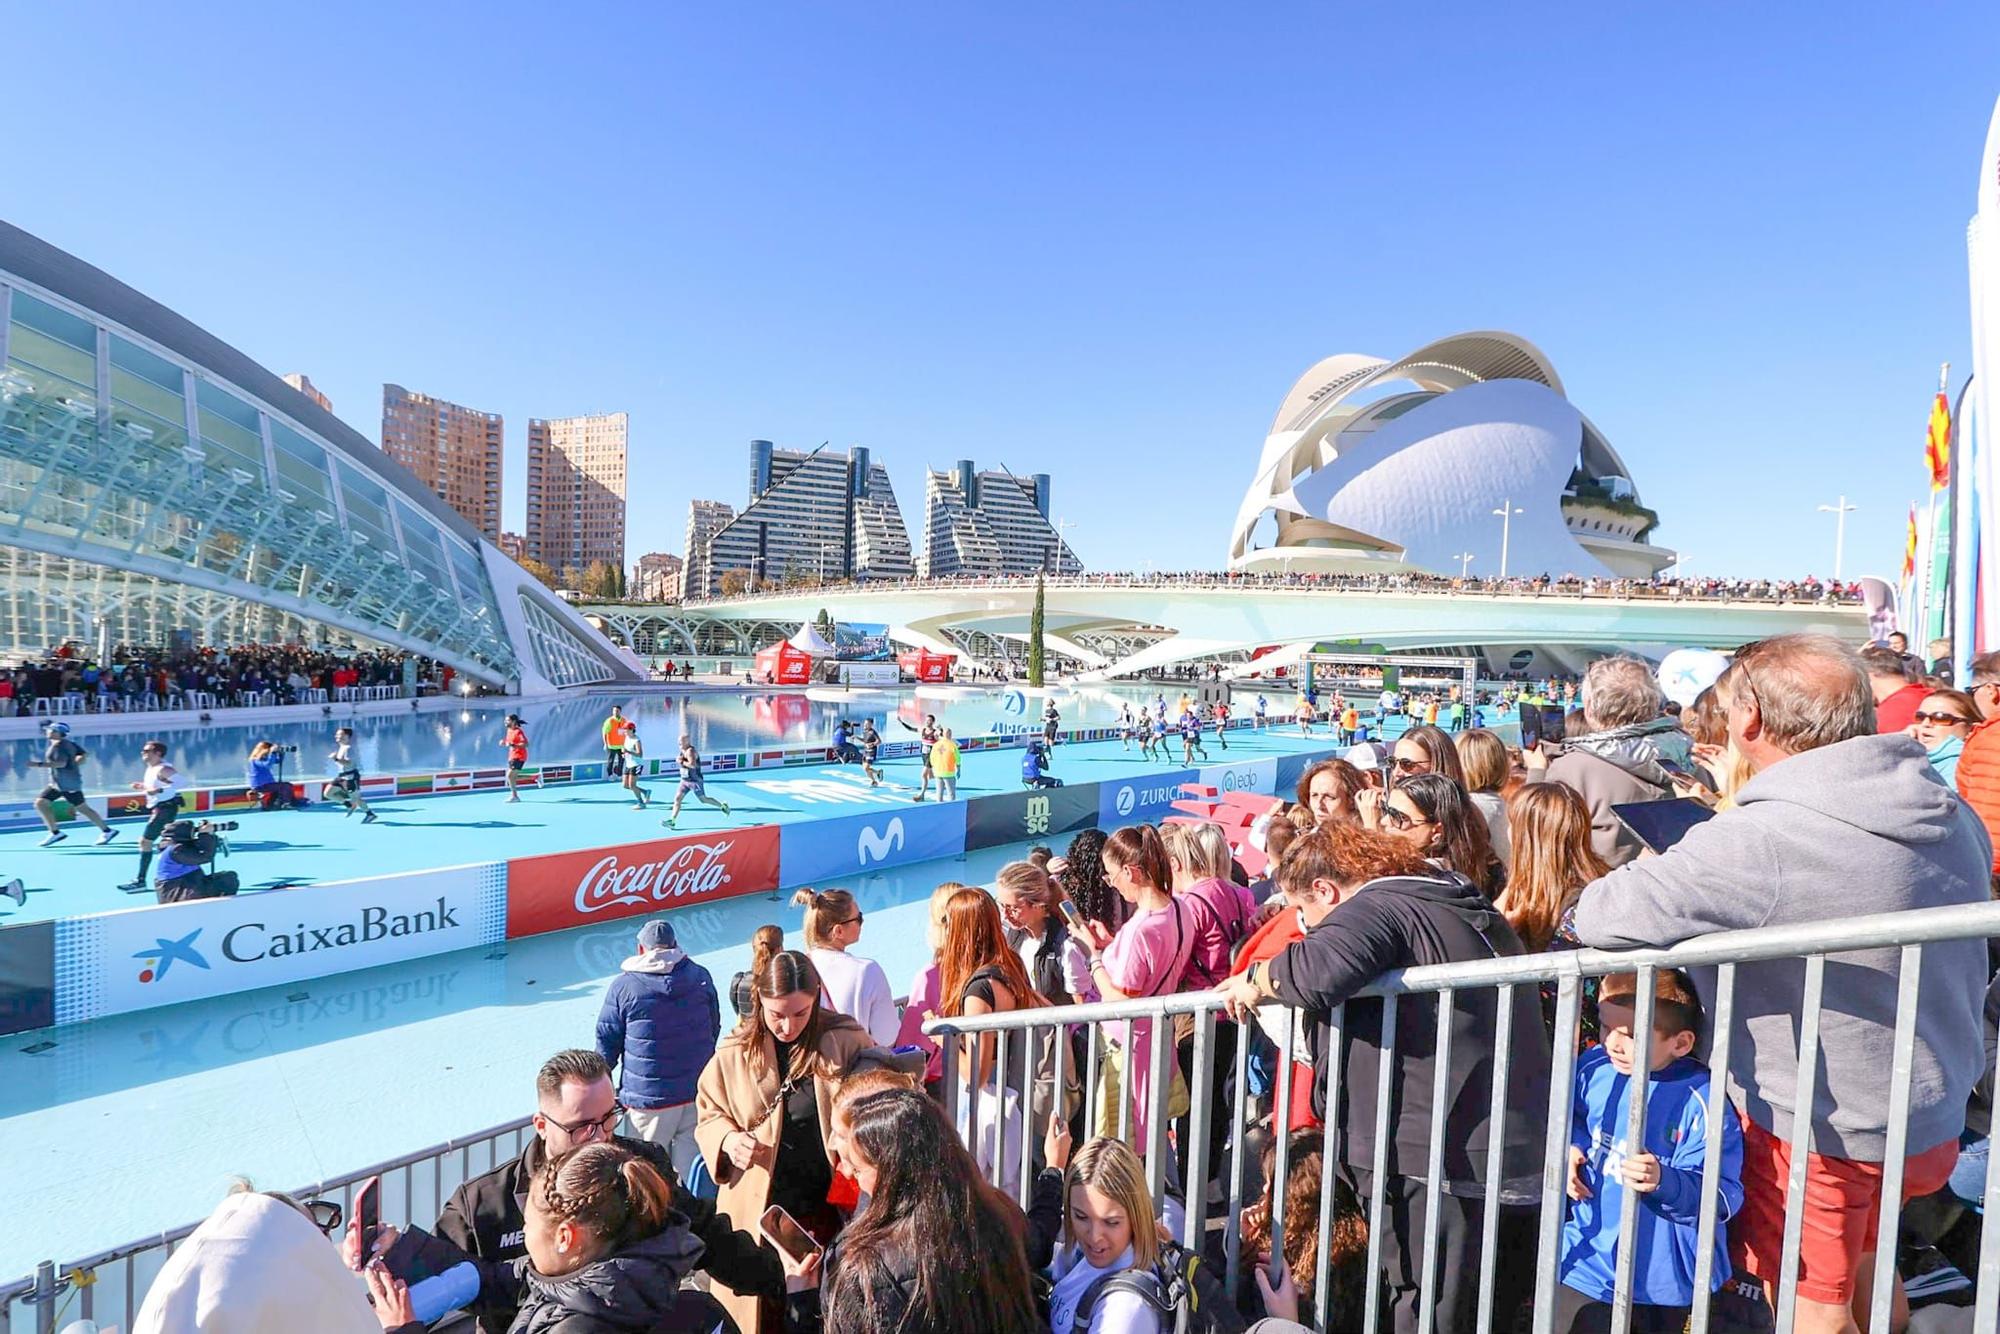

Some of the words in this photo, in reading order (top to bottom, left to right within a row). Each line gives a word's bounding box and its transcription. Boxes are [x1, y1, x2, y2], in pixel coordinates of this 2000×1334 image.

[1140, 785, 1186, 806] ZURICH
[574, 839, 736, 913] Coca-Cola
[221, 896, 460, 963] CaixaBank
